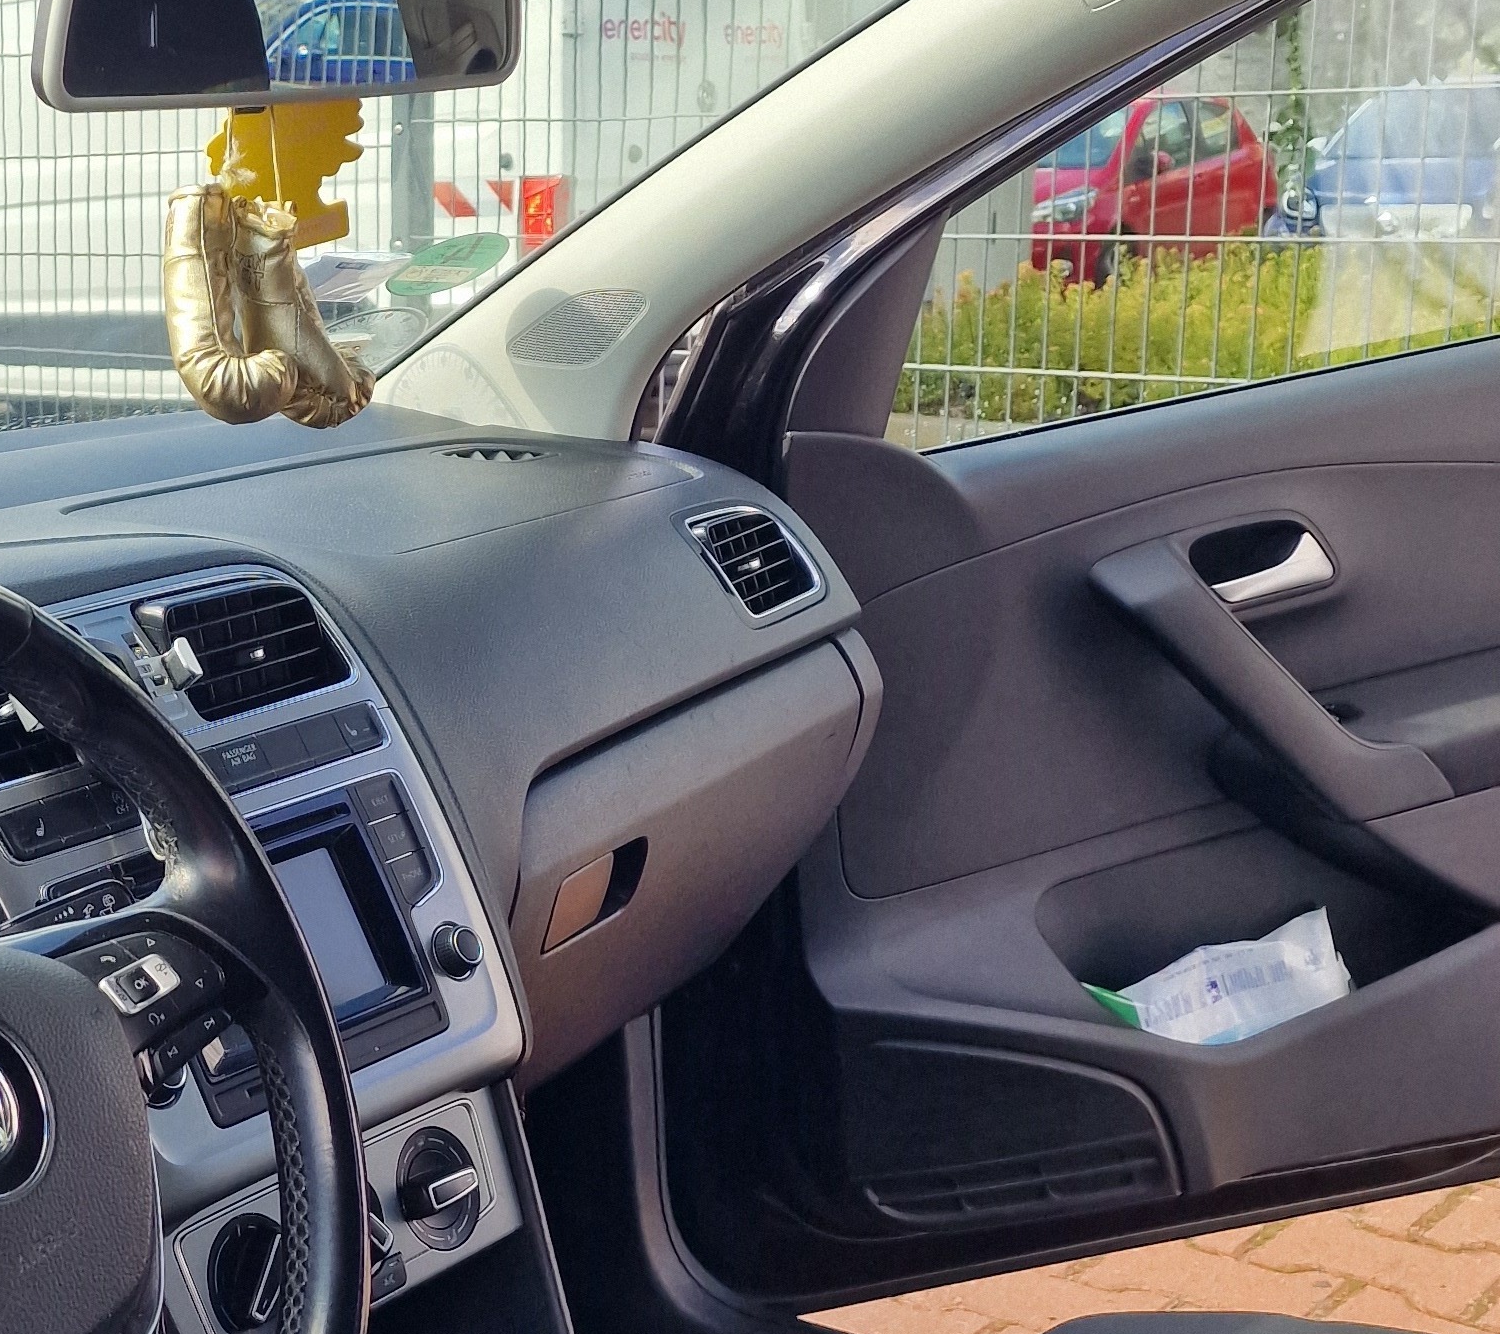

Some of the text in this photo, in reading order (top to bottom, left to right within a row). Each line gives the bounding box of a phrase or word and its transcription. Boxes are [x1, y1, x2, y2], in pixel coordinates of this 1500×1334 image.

[603, 11, 686, 49] enercity
[723, 19, 784, 50] enercity
[134, 975, 150, 990] OK
